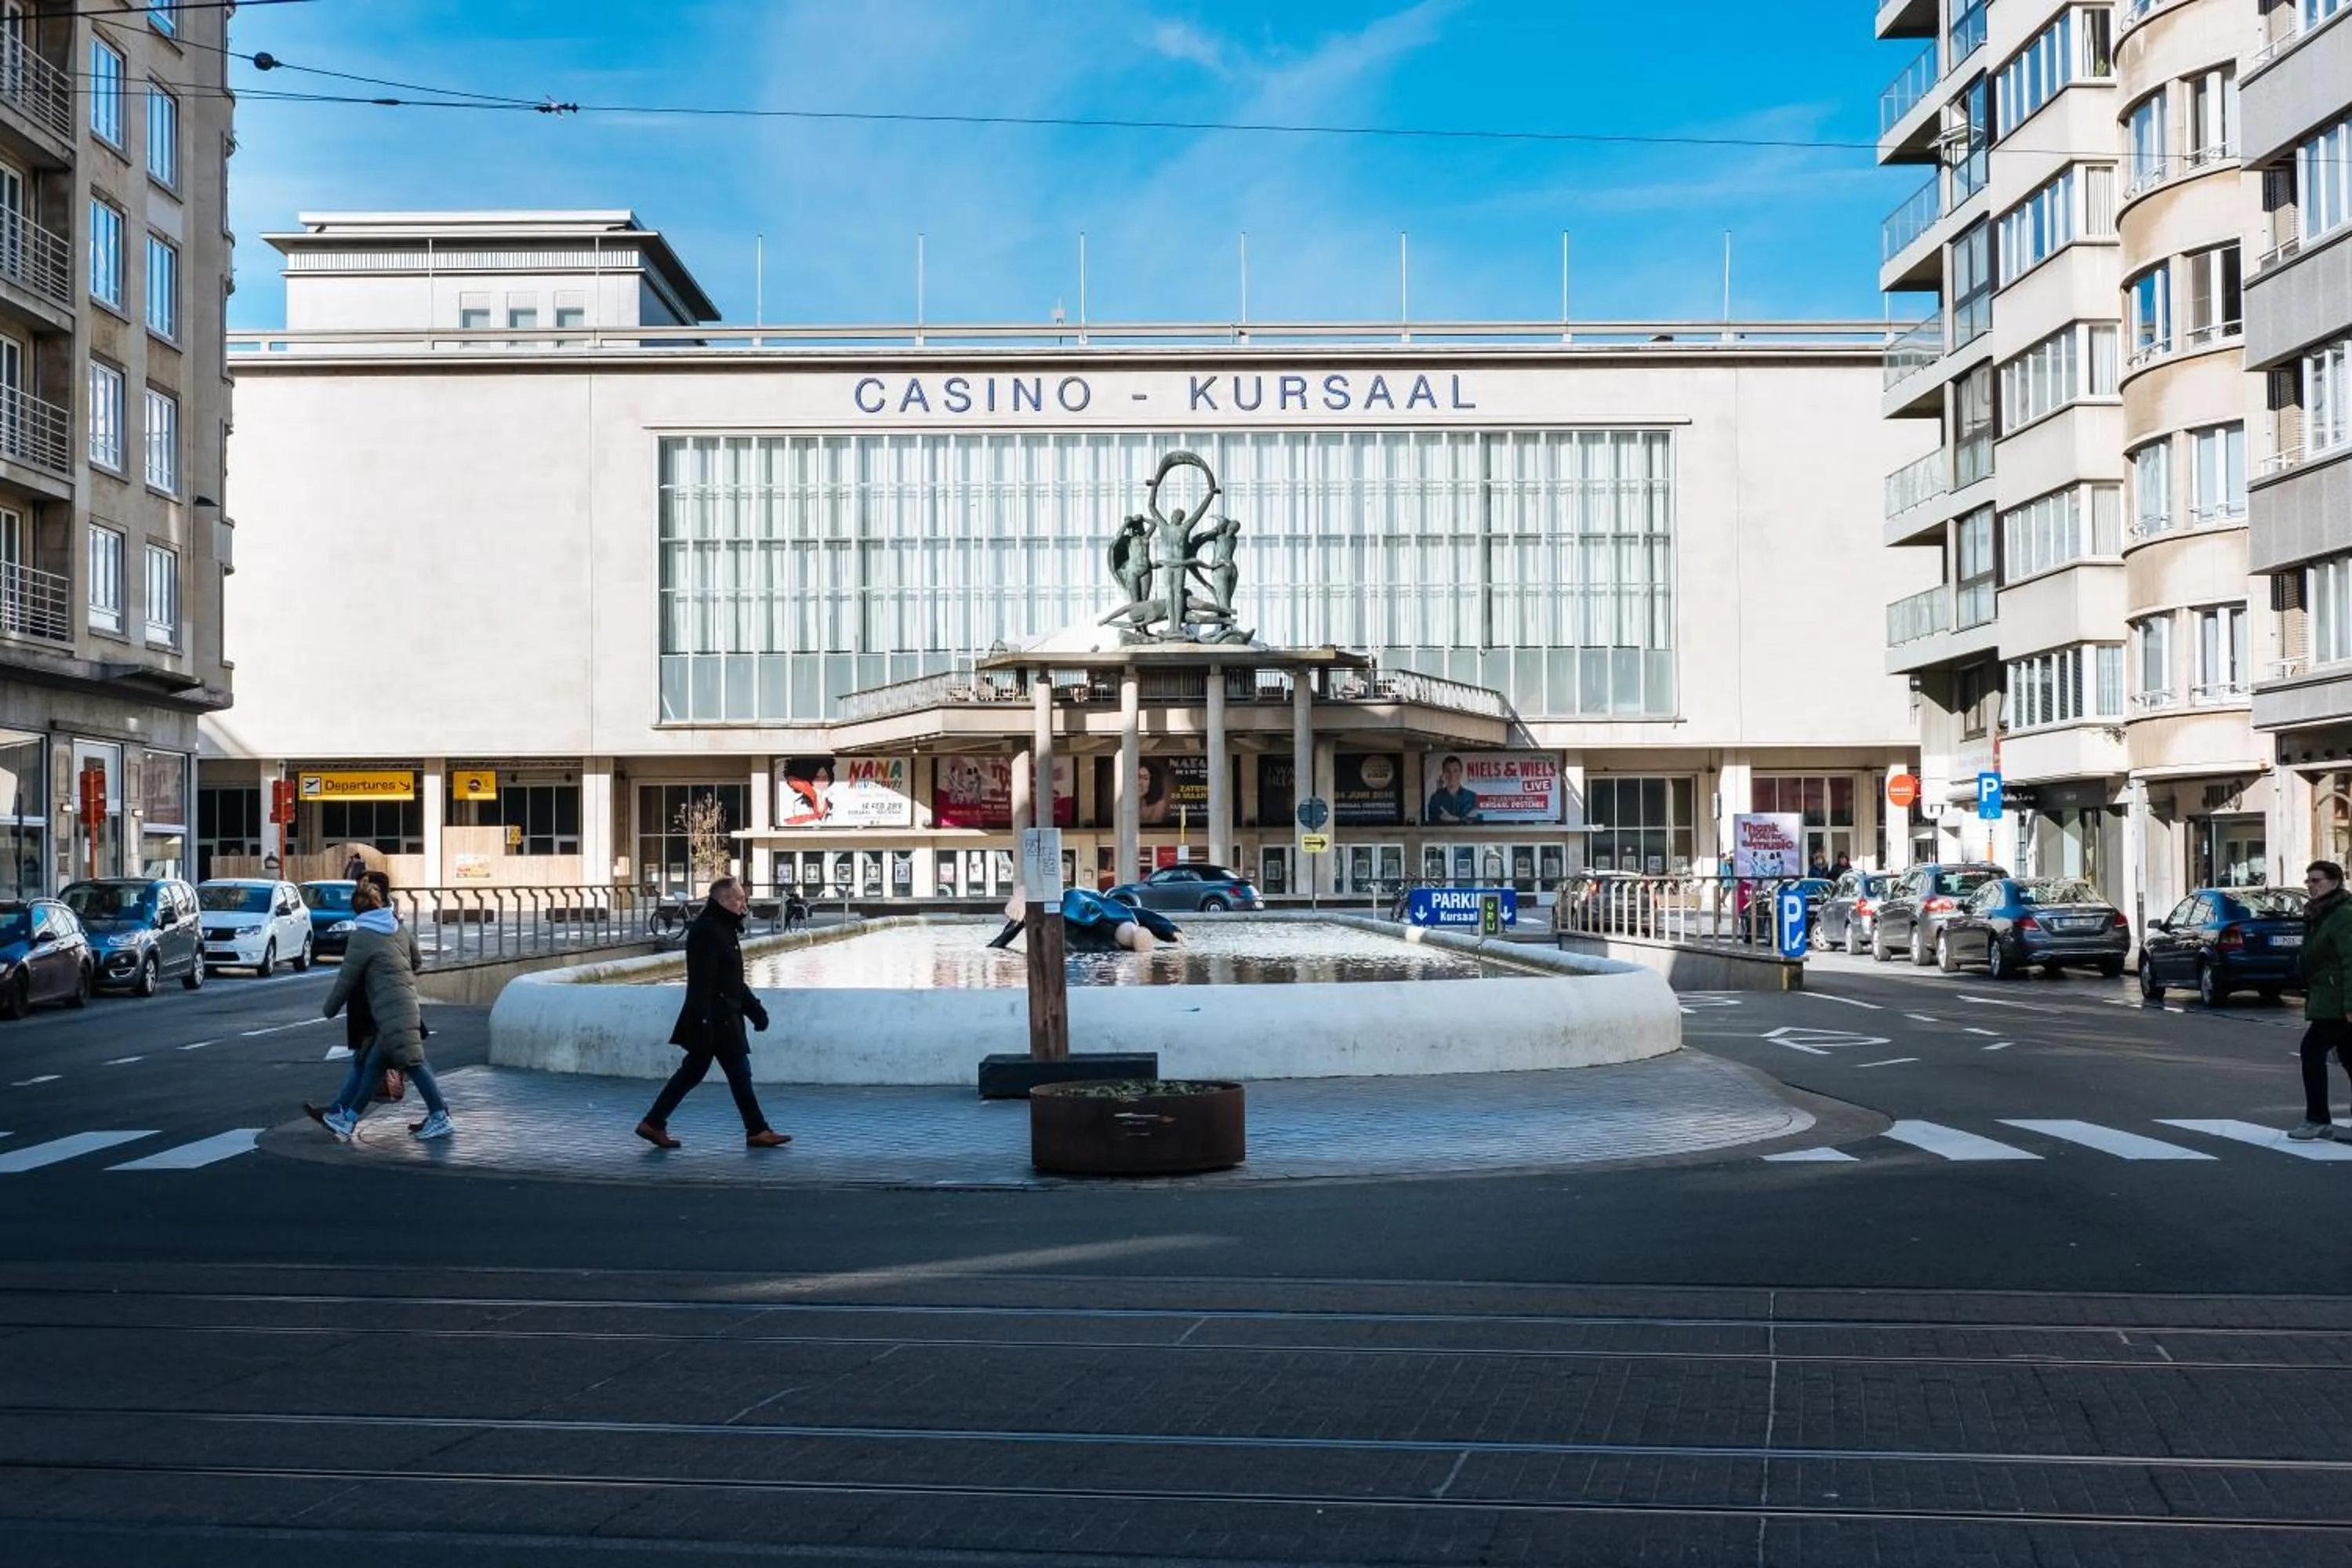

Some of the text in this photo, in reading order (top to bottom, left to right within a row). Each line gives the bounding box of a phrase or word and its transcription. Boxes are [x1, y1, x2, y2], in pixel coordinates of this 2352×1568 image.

[855, 376, 1091, 413] CASINO
[1189, 374, 1478, 412] KURSAAL
[848, 760, 902, 781] NANA
[1467, 761, 1556, 776] NIELS & WIELS
[325, 779, 396, 792] Departures
[1524, 780, 1550, 791] LIVE
[1981, 778, 1998, 802] P
[1432, 892, 1481, 909] PARKI
[1439, 909, 1479, 922] Kursaal
[1784, 895, 1802, 951] P
